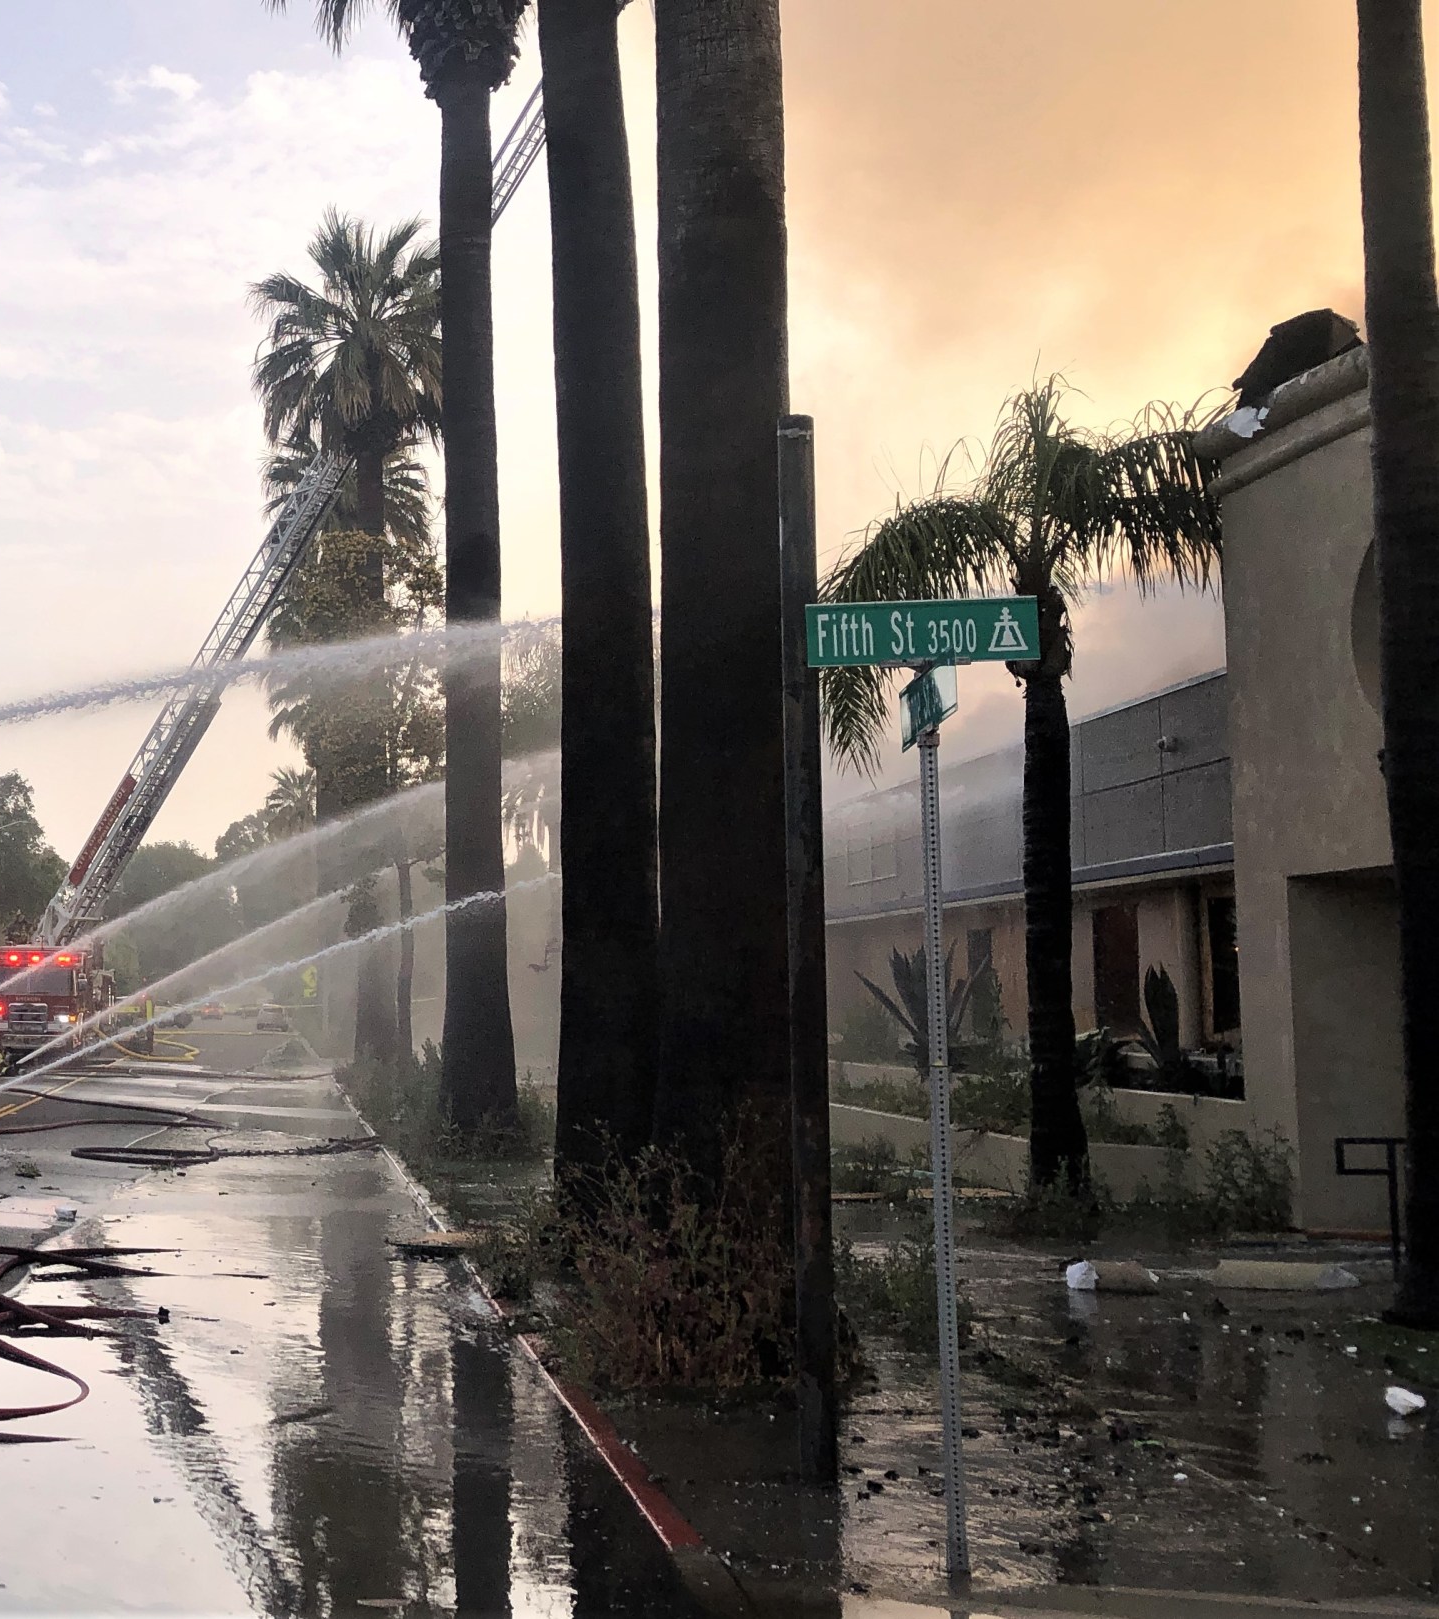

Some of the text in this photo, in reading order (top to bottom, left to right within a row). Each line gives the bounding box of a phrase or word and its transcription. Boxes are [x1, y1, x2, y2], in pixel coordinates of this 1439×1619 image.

[817, 610, 977, 658] Fifth St 3500
